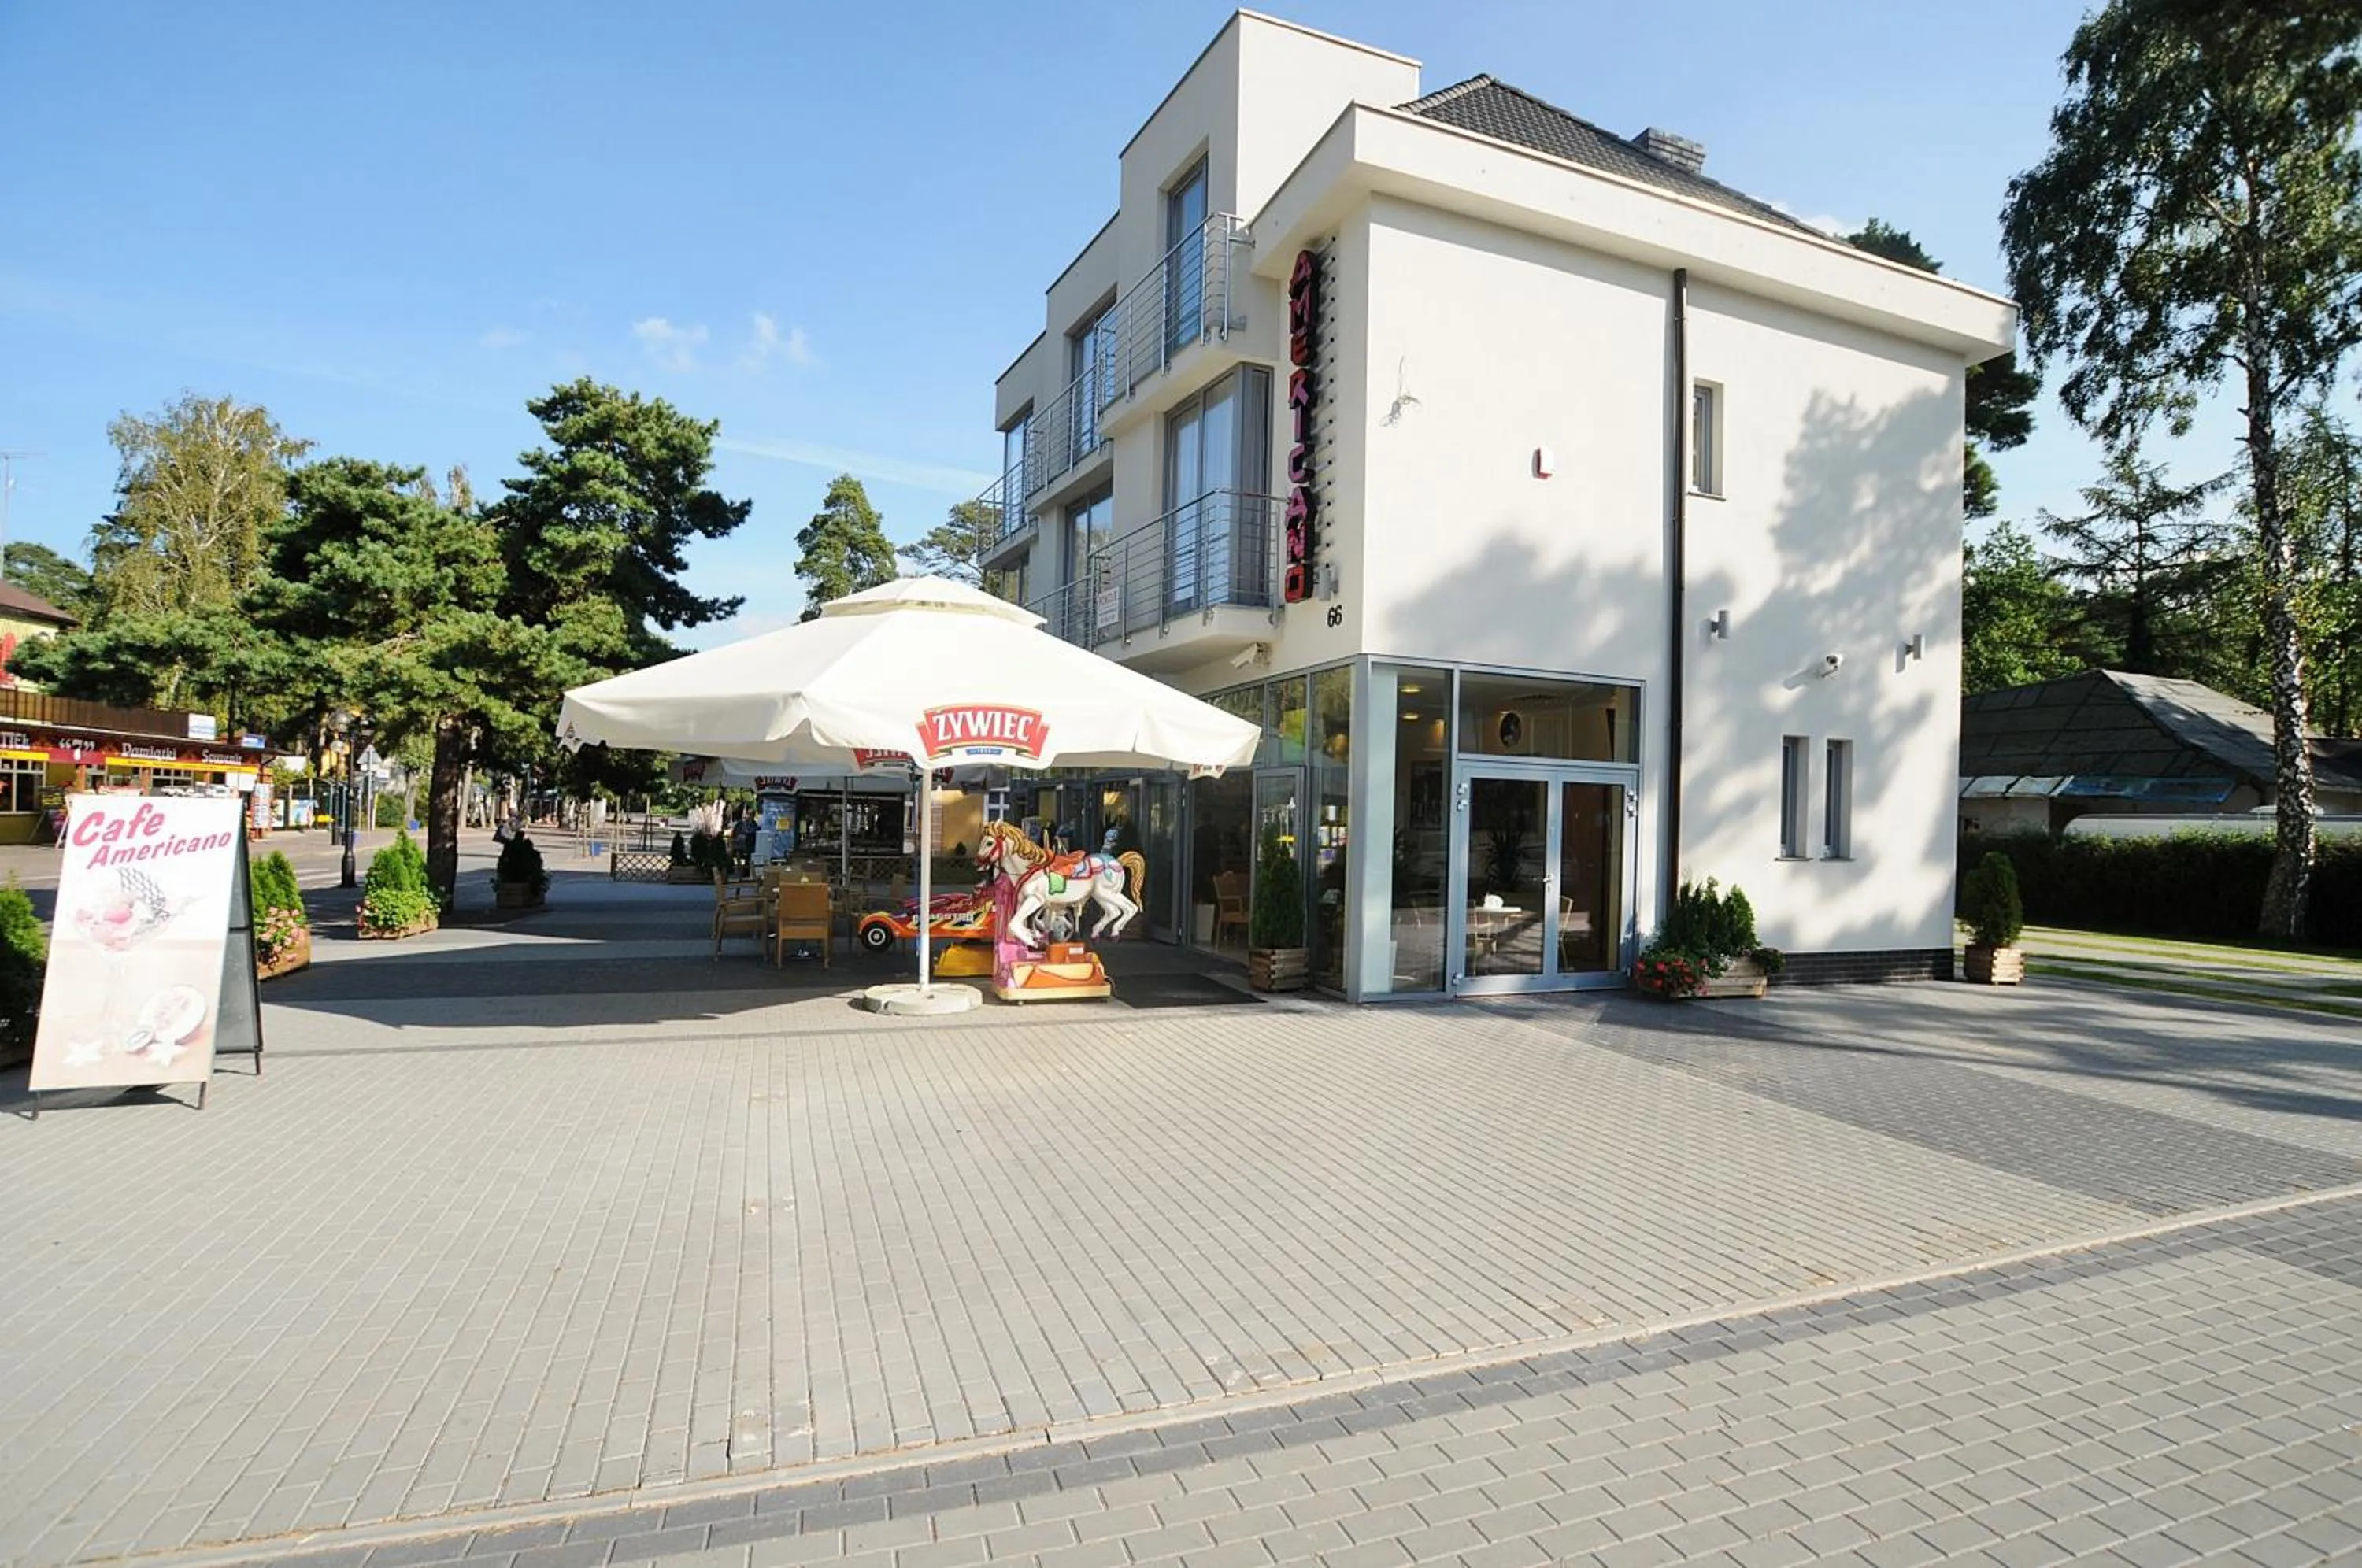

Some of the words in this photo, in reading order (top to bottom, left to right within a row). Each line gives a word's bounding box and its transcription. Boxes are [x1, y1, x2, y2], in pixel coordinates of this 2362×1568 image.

[1284, 250, 1316, 603] AMERICANO
[1327, 604, 1342, 628] 66
[932, 710, 1034, 741] ŻYWIEC
[72, 802, 165, 847] Cafe
[86, 831, 232, 870] Americano
